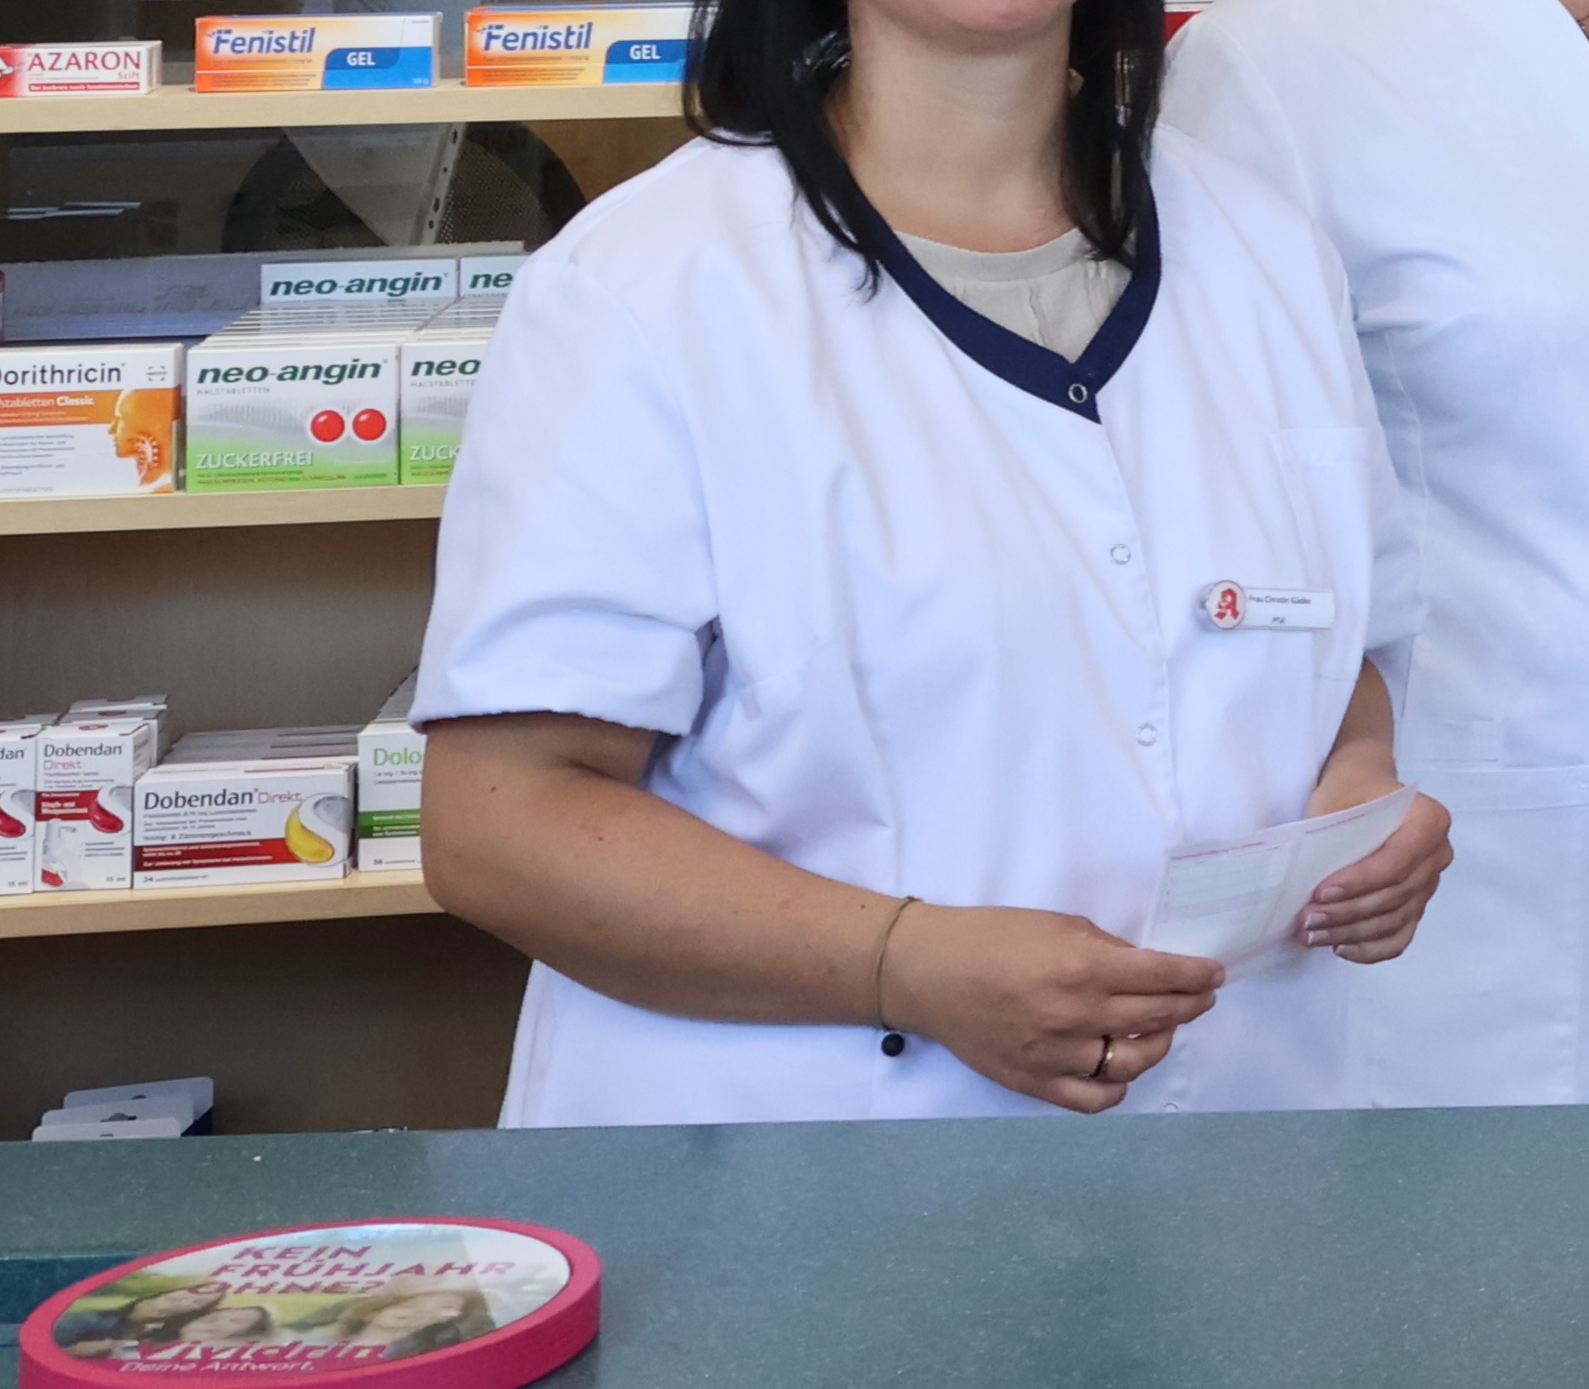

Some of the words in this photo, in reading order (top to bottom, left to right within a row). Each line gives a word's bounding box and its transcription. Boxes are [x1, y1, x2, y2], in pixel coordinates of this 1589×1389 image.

[212, 27, 314, 54] Fenistil
[483, 22, 594, 50] Fenistil
[28, 51, 141, 72] AZARON
[346, 51, 375, 67] GEL
[629, 44, 661, 61] GEL
[270, 273, 443, 299] neo-angin
[4, 363, 122, 385] orithricin
[198, 359, 381, 386] neo-angin
[57, 395, 94, 407] Classic
[196, 451, 313, 470] ZUCKERFREI
[43, 743, 123, 758] Dobendan
[144, 791, 255, 810] Dobendan
[258, 791, 302, 804] Direkt
[232, 1246, 371, 1261] KEIN
[210, 1258, 515, 1279] FRÜHJAHR
[187, 1280, 387, 1296] OHNE?
[132, 1340, 388, 1361] Vividrin
[119, 1361, 197, 1374] Deine
[206, 1359, 314, 1373] Antwort.
